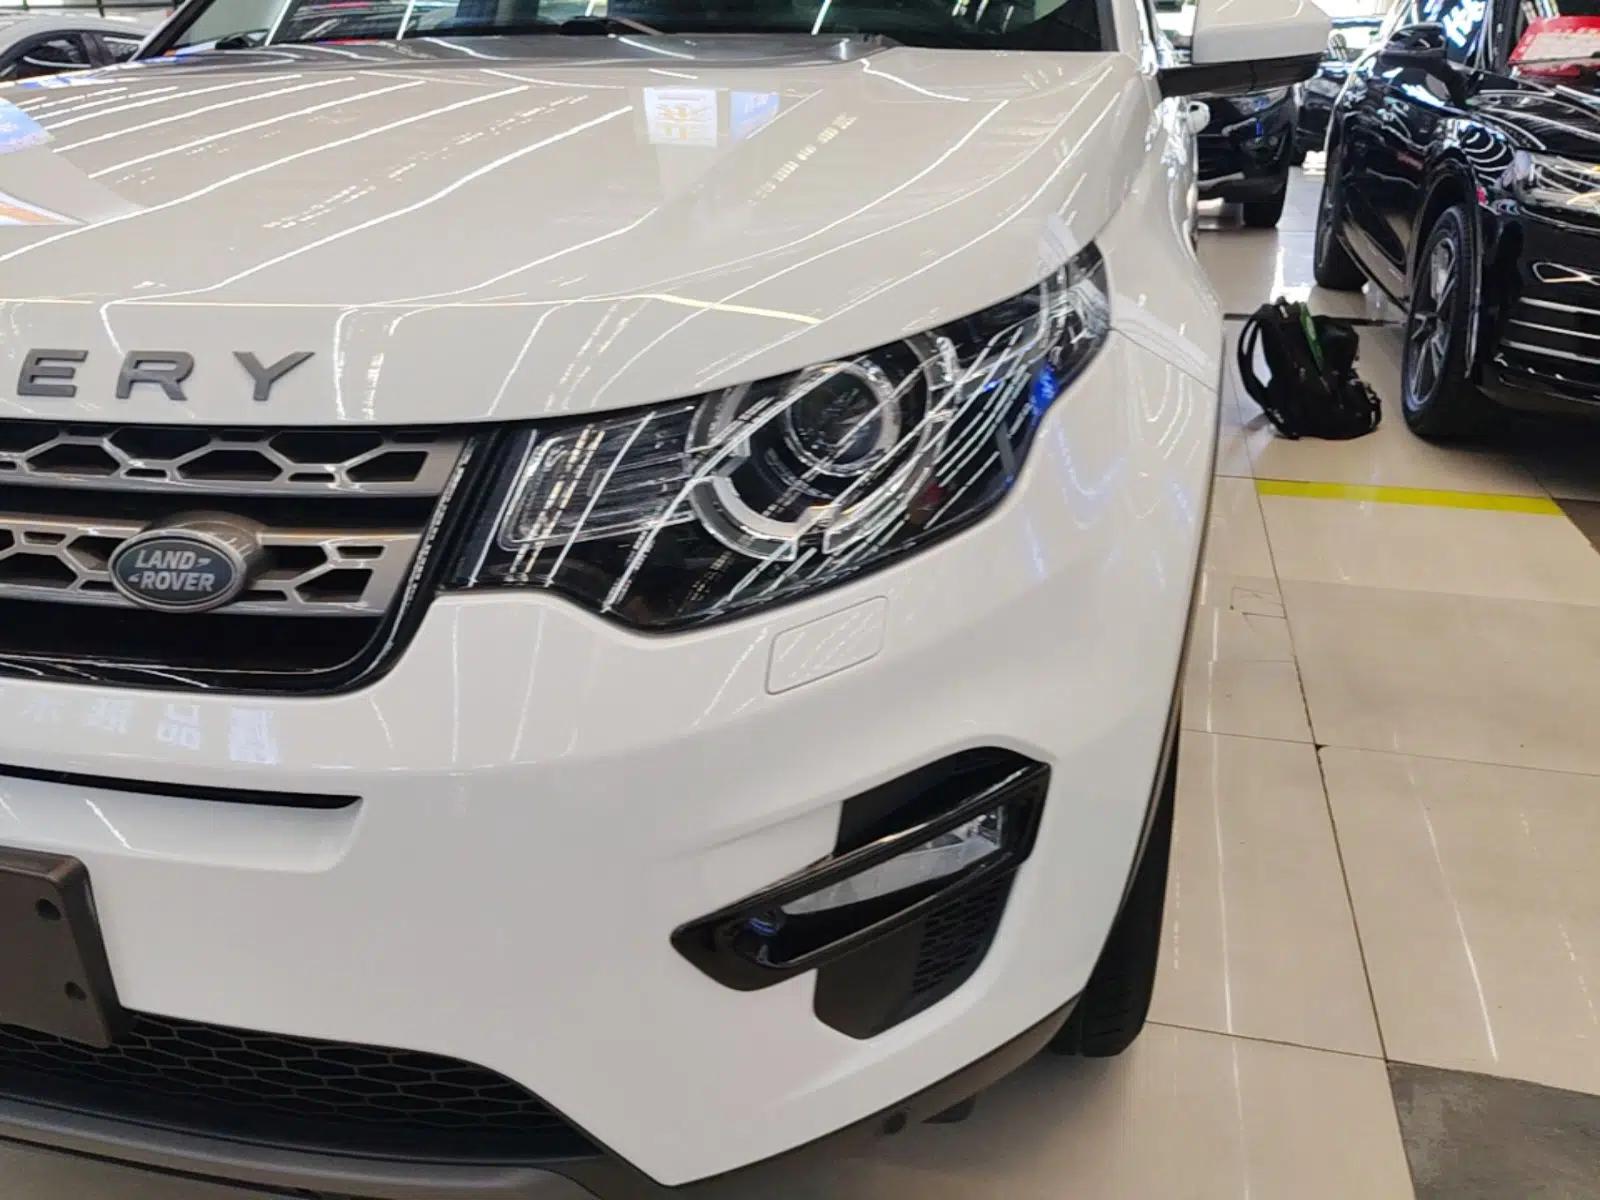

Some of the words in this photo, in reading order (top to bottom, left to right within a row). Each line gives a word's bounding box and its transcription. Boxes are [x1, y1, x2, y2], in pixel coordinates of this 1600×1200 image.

[17, 348, 315, 401] ERY
[135, 549, 197, 571] LAND
[140, 570, 216, 592] ROVER
